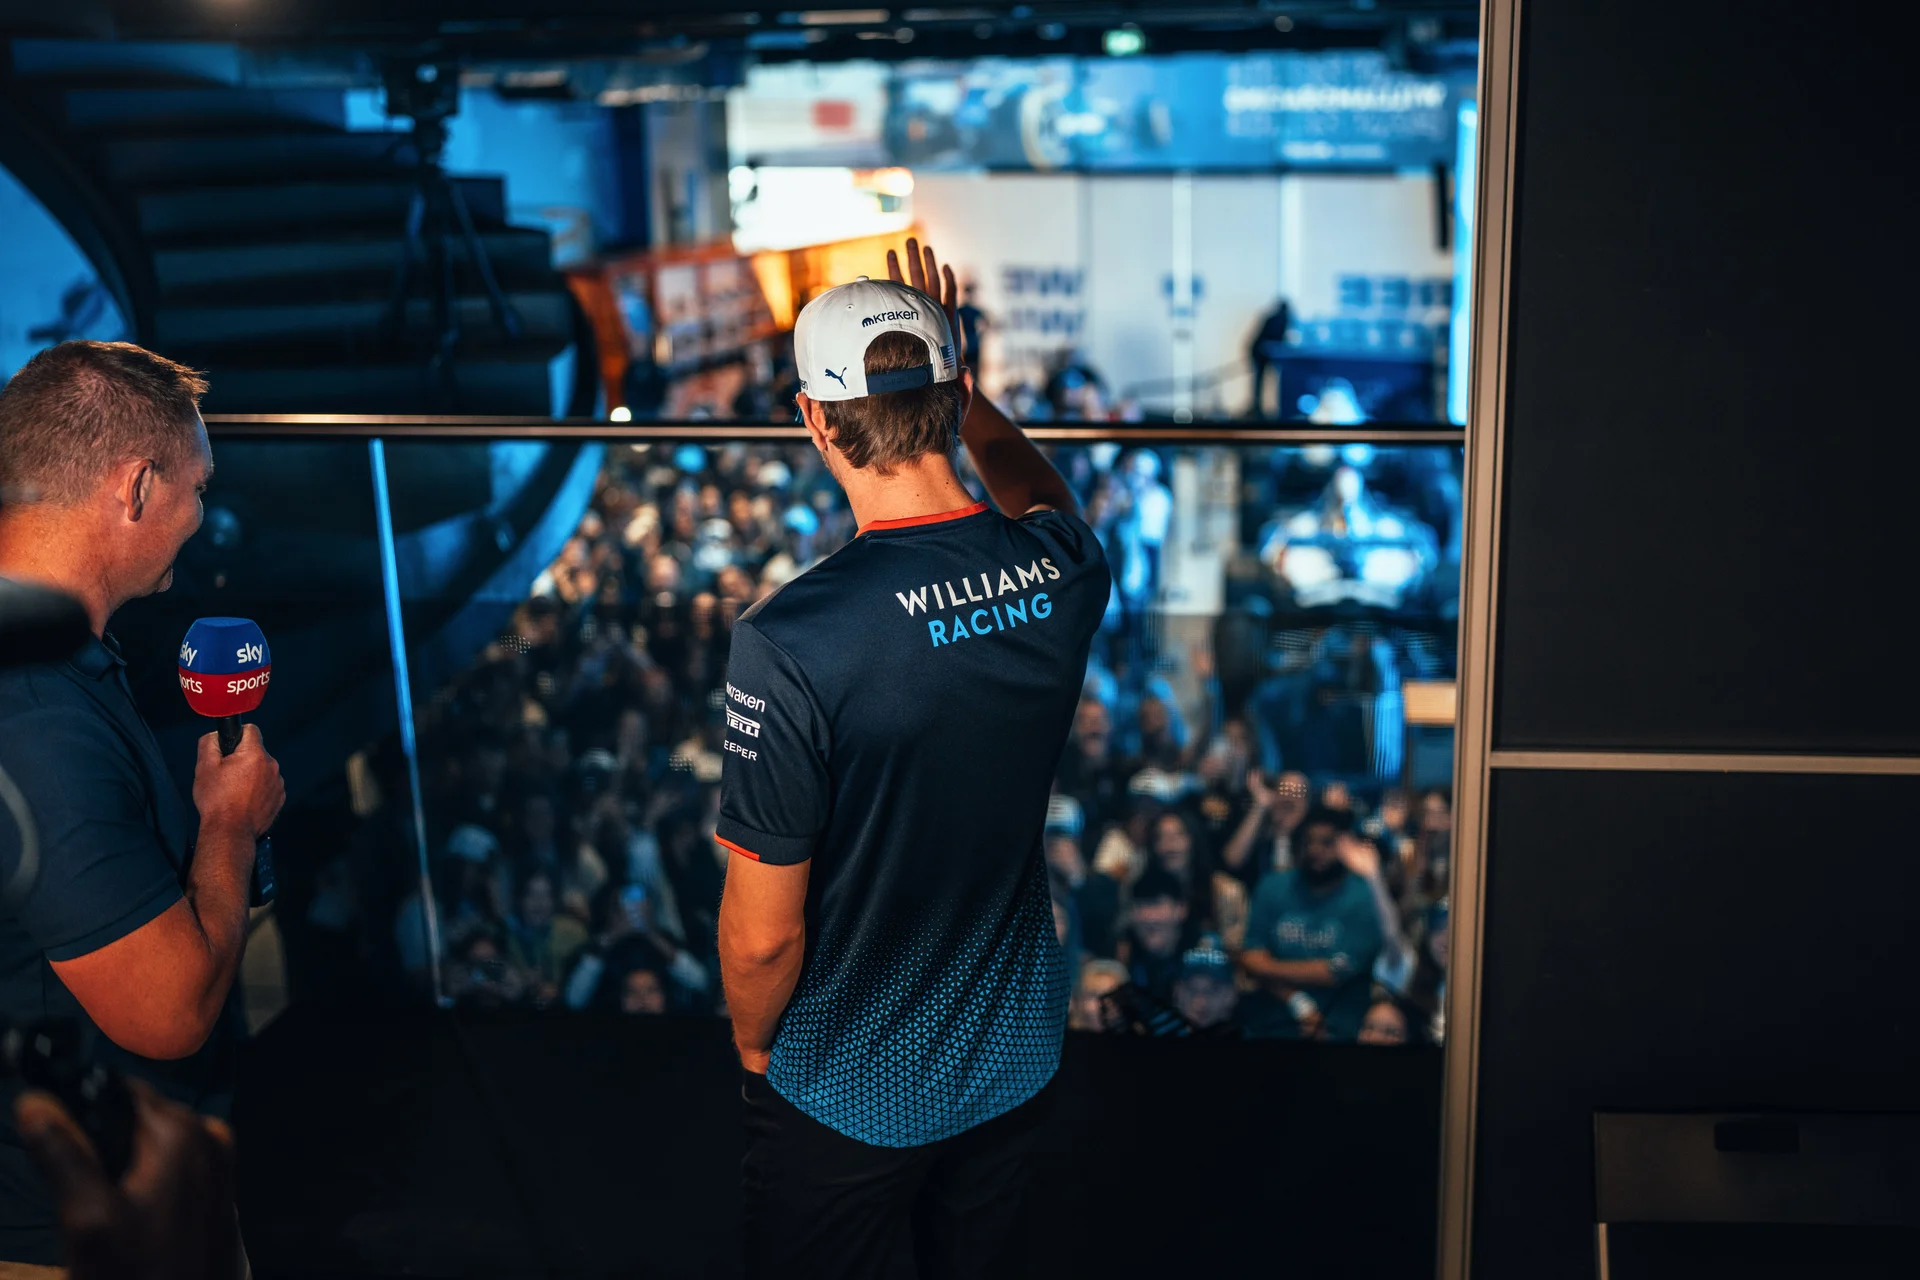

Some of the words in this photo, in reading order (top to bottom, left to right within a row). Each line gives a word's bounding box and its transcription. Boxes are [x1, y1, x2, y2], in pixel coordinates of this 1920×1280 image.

[873, 310, 919, 324] kraken
[895, 557, 1061, 617] WILLIAMS
[928, 592, 1053, 648] RACING
[236, 642, 263, 664] sky
[179, 673, 203, 694] orts
[226, 671, 270, 695] sports
[723, 739, 758, 761] EEPER
